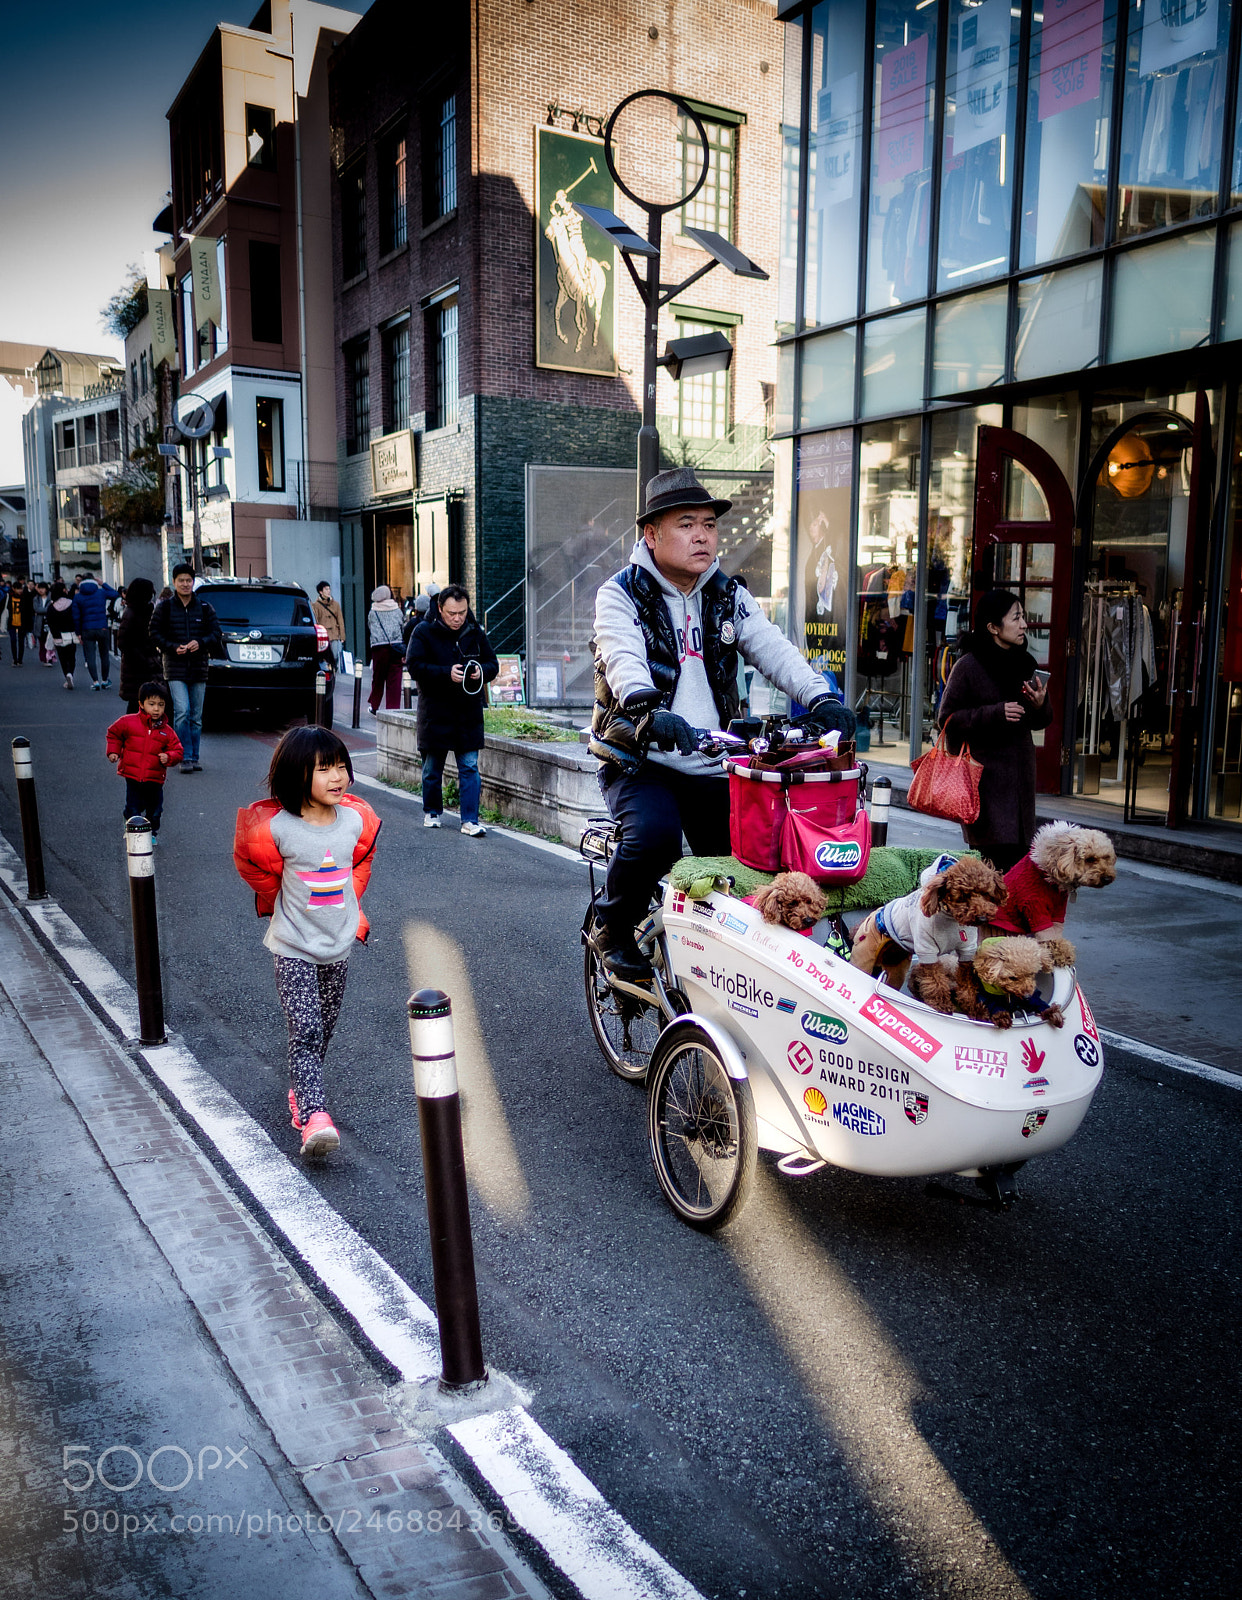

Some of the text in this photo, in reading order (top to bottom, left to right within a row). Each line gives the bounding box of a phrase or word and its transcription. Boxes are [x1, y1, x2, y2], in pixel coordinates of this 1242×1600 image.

[893, 51, 916, 75] 2018
[890, 66, 918, 91] SALE
[199, 251, 211, 300] CANAAN
[155, 301, 166, 343] CANAAN
[803, 622, 838, 637] JOYRICH
[822, 649, 847, 663] DOGG
[819, 844, 860, 863] Watts
[786, 949, 804, 968] No
[805, 962, 836, 990] Drop
[709, 965, 774, 1008] trioBike
[733, 1001, 758, 1018] MICHELIN
[803, 1011, 849, 1040] Watts
[866, 999, 934, 1055] Supreme
[819, 1049, 910, 1085] GOOD DESIGN
[819, 1068, 900, 1103] AWARD 2011
[804, 1113, 830, 1127] Shell
[833, 1102, 886, 1125] MAGNETI
[833, 1114, 886, 1136] MARELLI
